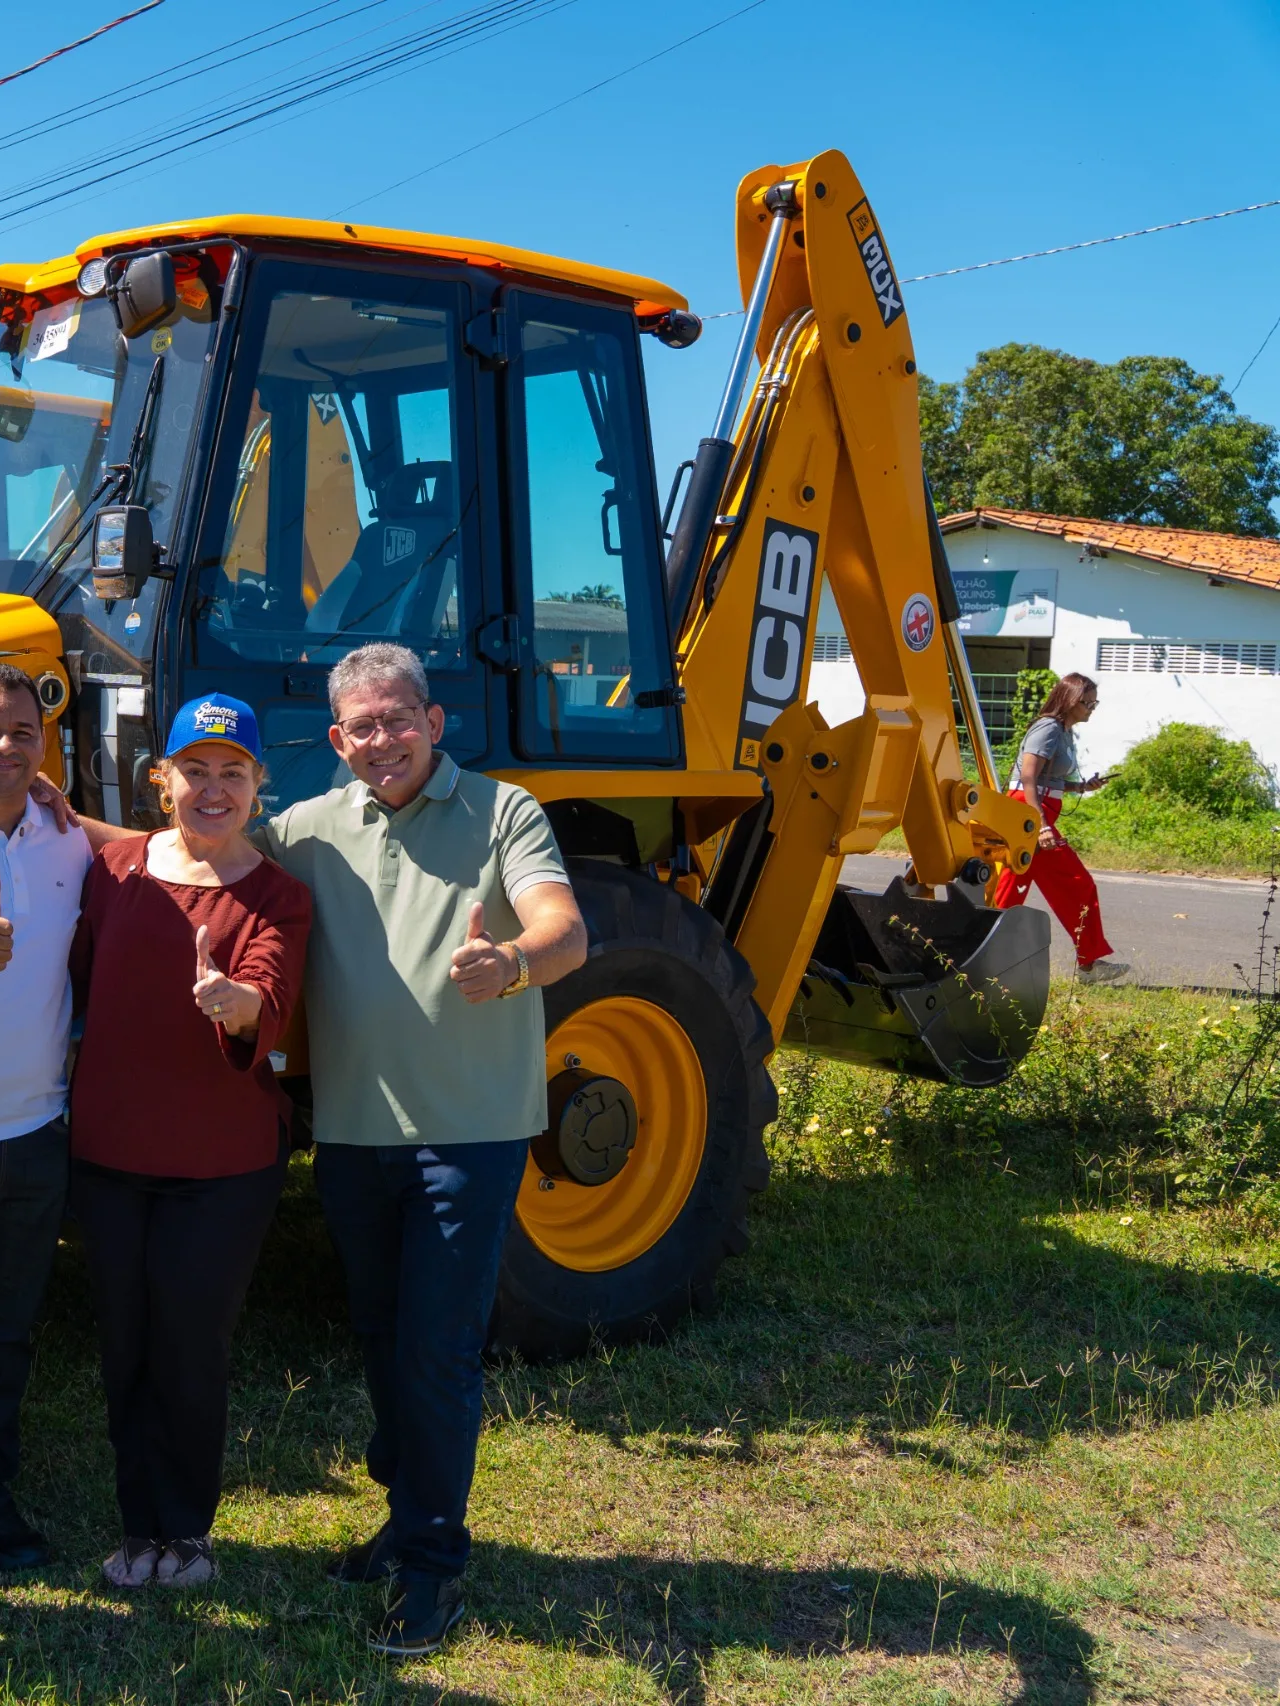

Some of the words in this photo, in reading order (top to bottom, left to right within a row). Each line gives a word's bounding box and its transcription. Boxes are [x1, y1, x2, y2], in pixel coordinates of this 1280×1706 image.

[386, 530, 416, 562] JCB
[954, 577, 987, 588] VILHÃO
[964, 602, 1000, 611] Roberto
[194, 702, 238, 722] Simone
[195, 716, 237, 728] Pereira
